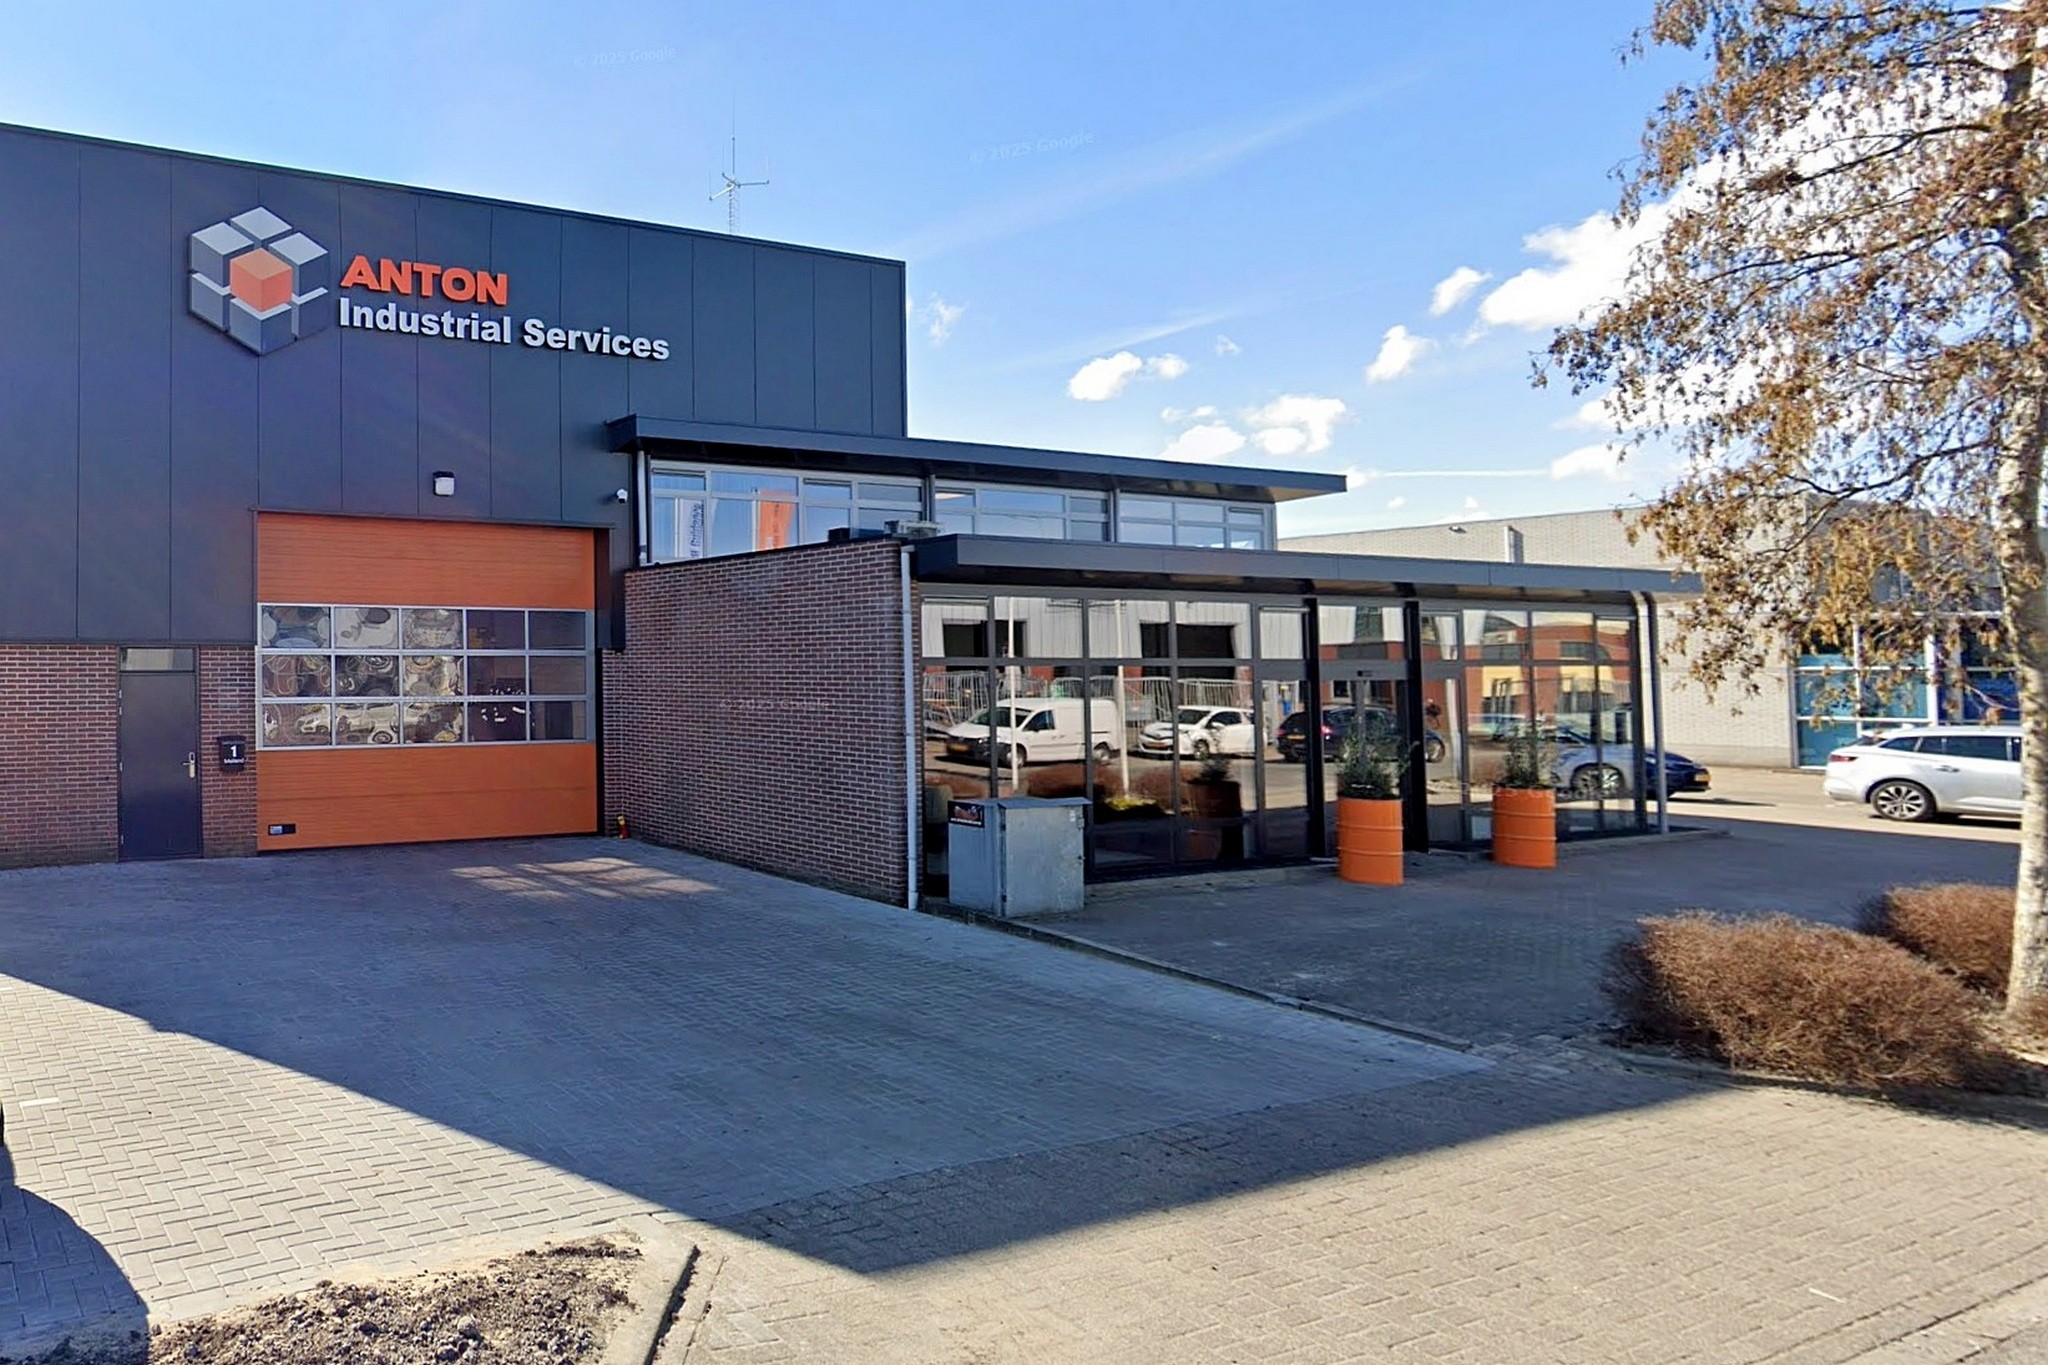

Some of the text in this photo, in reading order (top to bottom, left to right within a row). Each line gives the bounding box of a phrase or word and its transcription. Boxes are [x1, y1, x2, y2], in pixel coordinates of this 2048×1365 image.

[341, 254, 509, 306] ANTON
[340, 297, 670, 361] Industrial Services
[230, 745, 237, 757] 1
